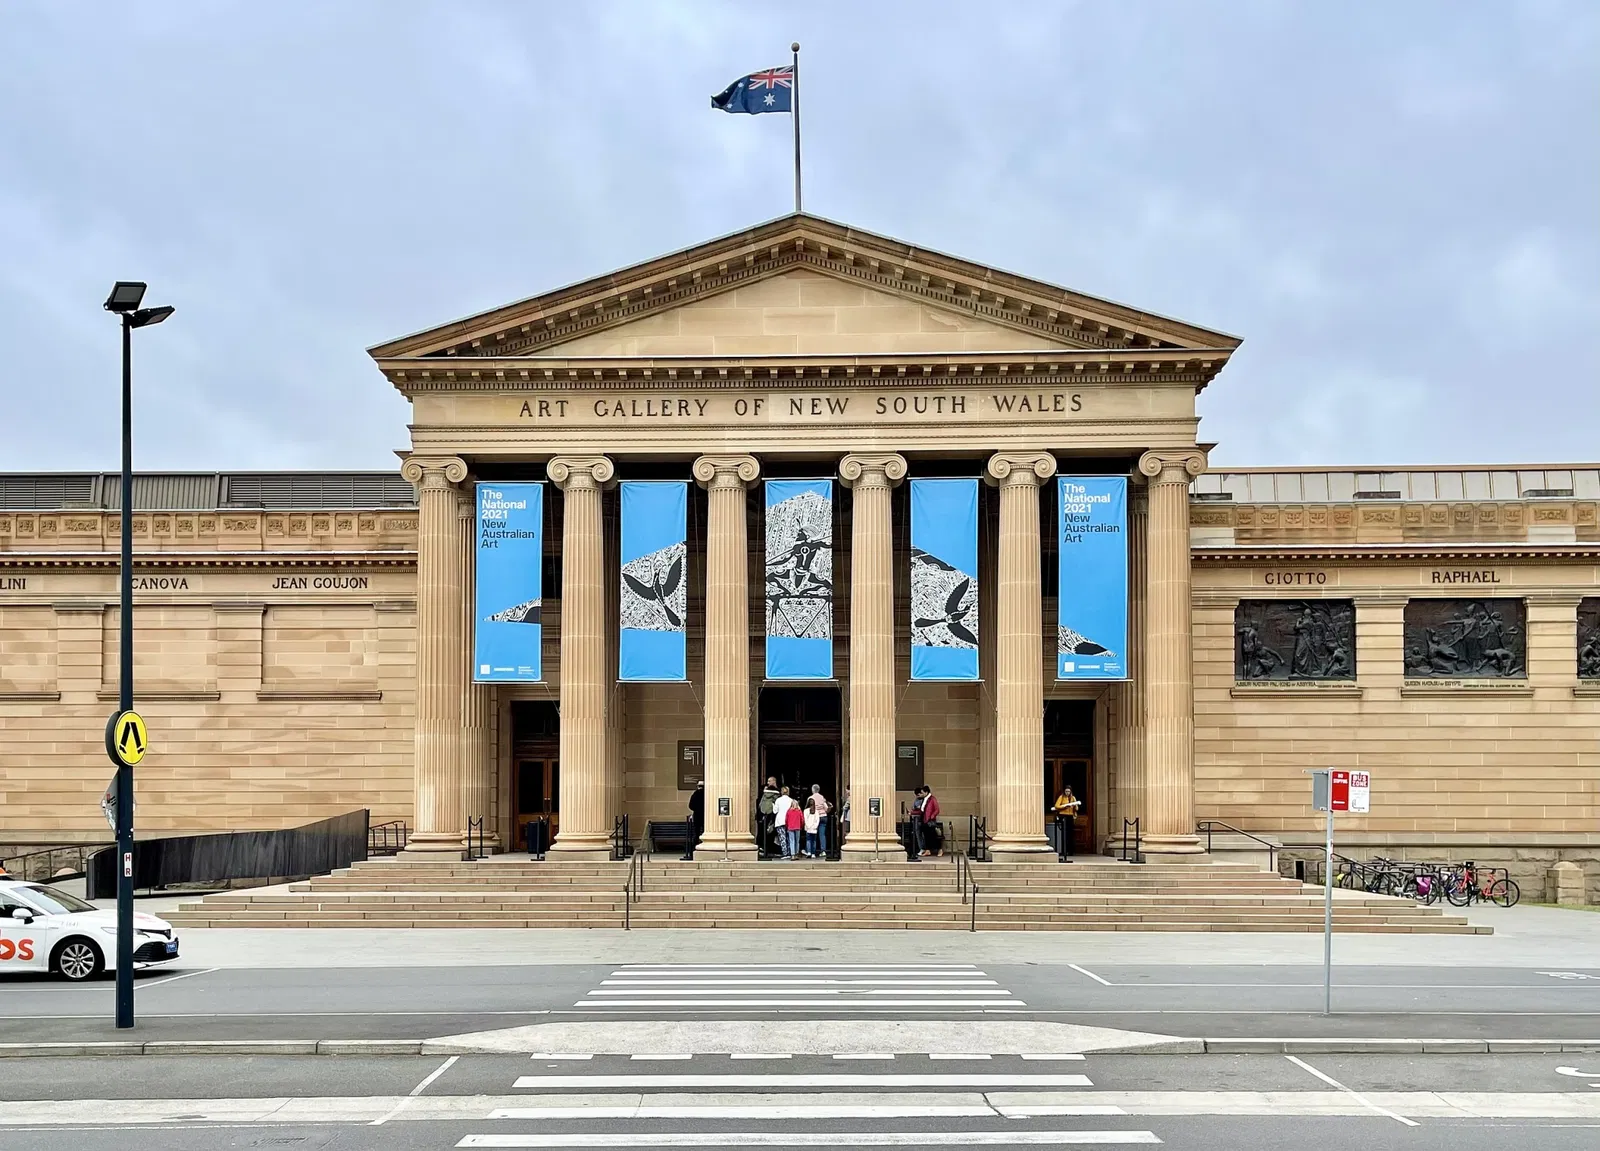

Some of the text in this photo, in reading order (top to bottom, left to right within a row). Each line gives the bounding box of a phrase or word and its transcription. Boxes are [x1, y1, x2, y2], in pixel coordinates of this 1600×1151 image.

[519, 393, 1083, 418] ART GALLERY OF NEW SOUTH WALES
[1063, 483, 1086, 493] The
[481, 489, 503, 499] The
[1063, 493, 1111, 503] National
[481, 499, 527, 509] National
[1063, 503, 1092, 513] 2021
[481, 509, 508, 519] 2021
[1064, 513, 1091, 523] New
[481, 519, 507, 529] New
[1063, 523, 1120, 533] Australian
[481, 529, 535, 539] Australian
[1063, 533, 1083, 543] Art
[481, 539, 499, 549] Art
[1264, 572, 1327, 585] GIOTTO
[1431, 571, 1501, 584] RAPHAEL
[131, 578, 189, 590] CANOVA
[272, 577, 368, 589] JEAN GOUJON
